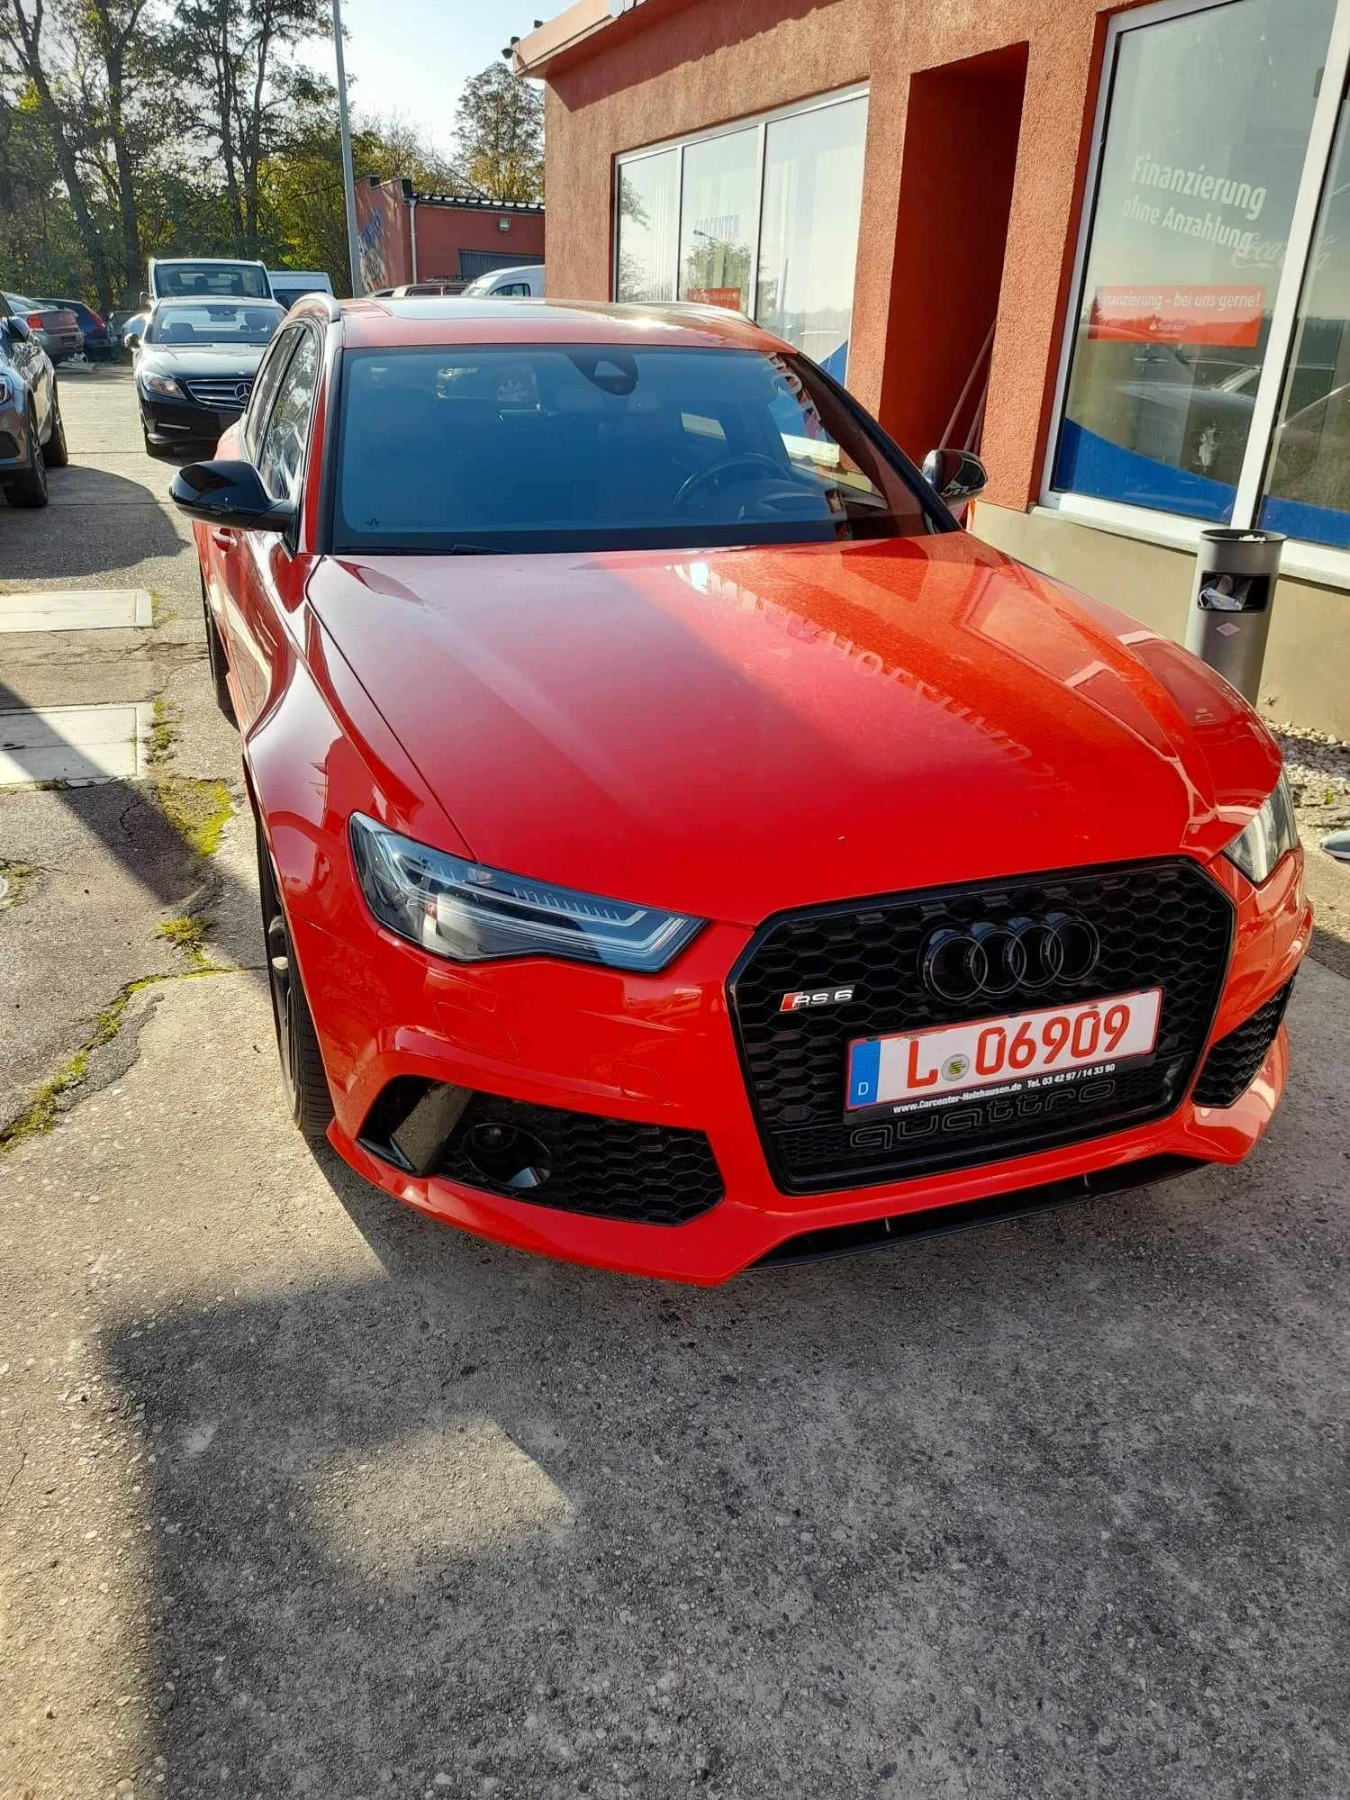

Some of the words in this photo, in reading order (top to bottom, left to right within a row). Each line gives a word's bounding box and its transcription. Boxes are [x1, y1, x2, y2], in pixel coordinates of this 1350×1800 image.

[1130, 153, 1267, 221] Finanzierung
[1122, 194, 1160, 225] ohne
[1161, 206, 1253, 259] Anzahlung
[1097, 290, 1163, 312] nanzierung
[1173, 291, 1191, 307] bei
[1194, 295, 1216, 308] uns
[1218, 292, 1262, 311] gerne!
[907, 1040, 939, 1089] L
[974, 1004, 1131, 1076] 06909
[849, 1078, 1116, 1151] quattro
[857, 1081, 869, 1096] D
[893, 1082, 1022, 1114] www.Carcenter-Holzhausen.de
[1042, 1076, 1053, 1086] 03
[1054, 1073, 1065, 1083] 42
[1065, 1071, 1077, 1081] 97
[1083, 1068, 1093, 1077] 14
[1093, 1065, 1104, 1075] 33
